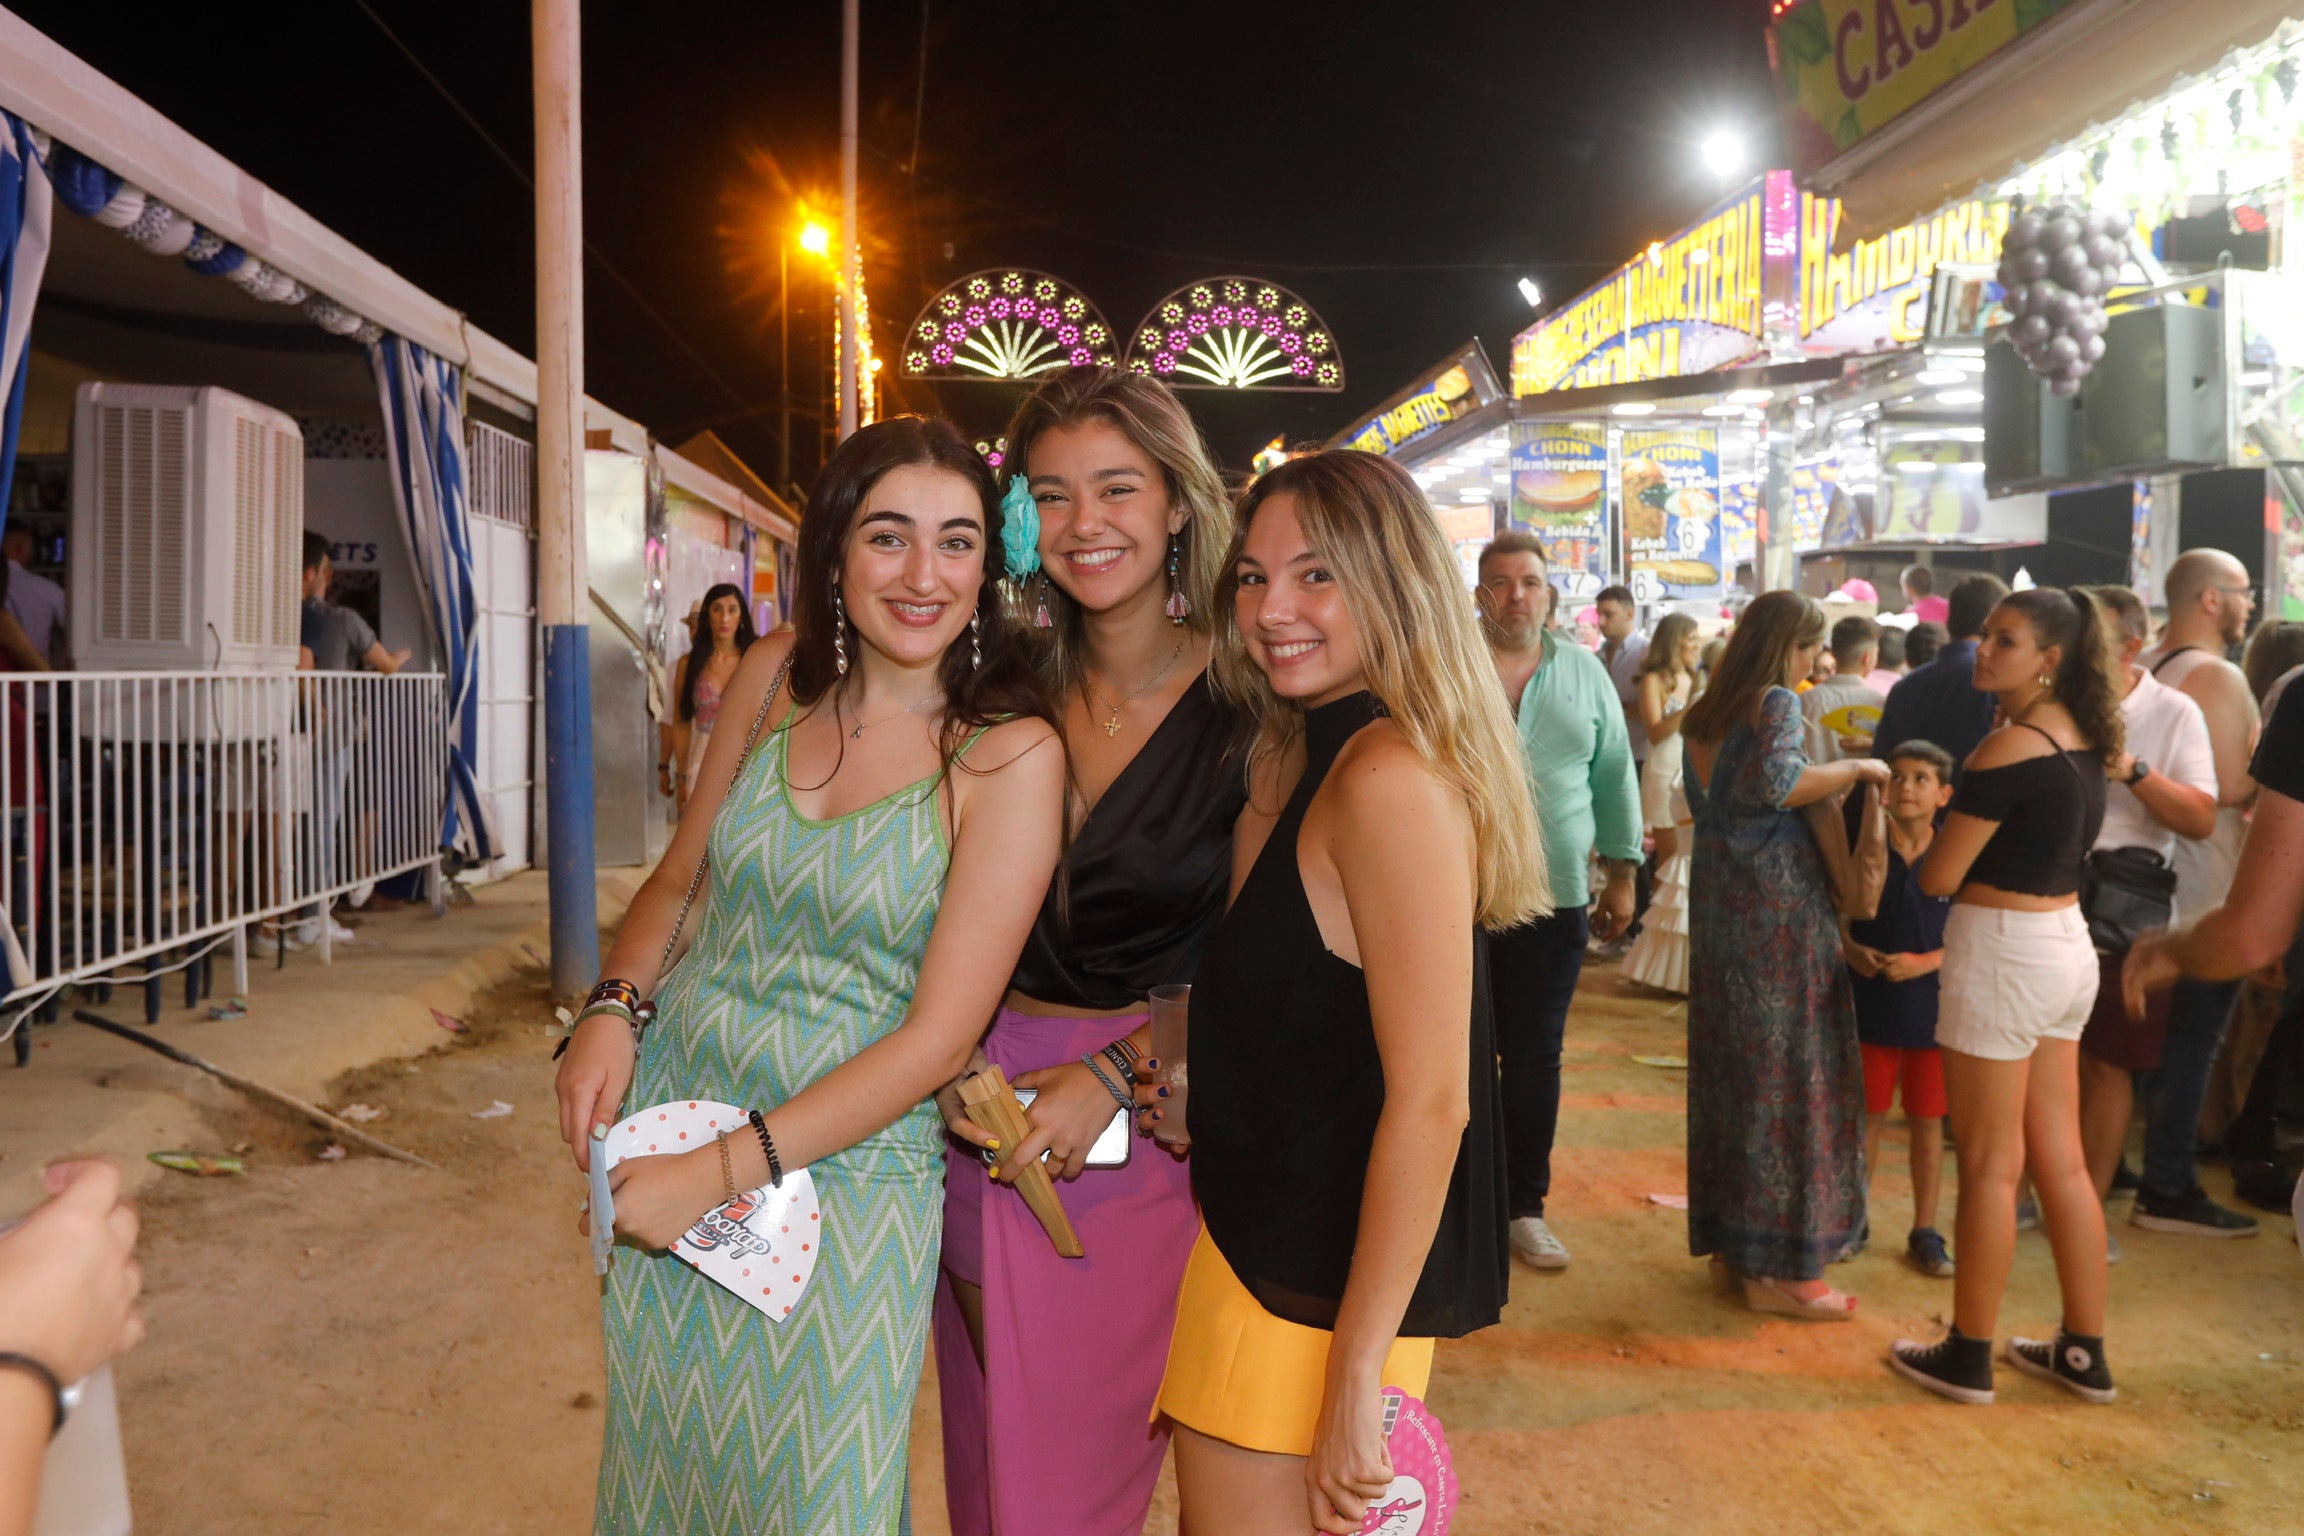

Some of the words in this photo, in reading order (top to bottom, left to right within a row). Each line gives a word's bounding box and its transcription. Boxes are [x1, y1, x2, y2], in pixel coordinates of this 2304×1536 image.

[1529, 440, 1592, 456] CHONI
[1641, 446, 1702, 462] CHONI
[1511, 456, 1607, 474] Hamburguesa
[1631, 536, 1667, 551] Kebab
[1683, 520, 1694, 549] 6
[331, 542, 378, 562] ETS
[1572, 572, 1586, 594] 7
[1635, 573, 1646, 601] 6
[1433, 1454, 1442, 1467] en
